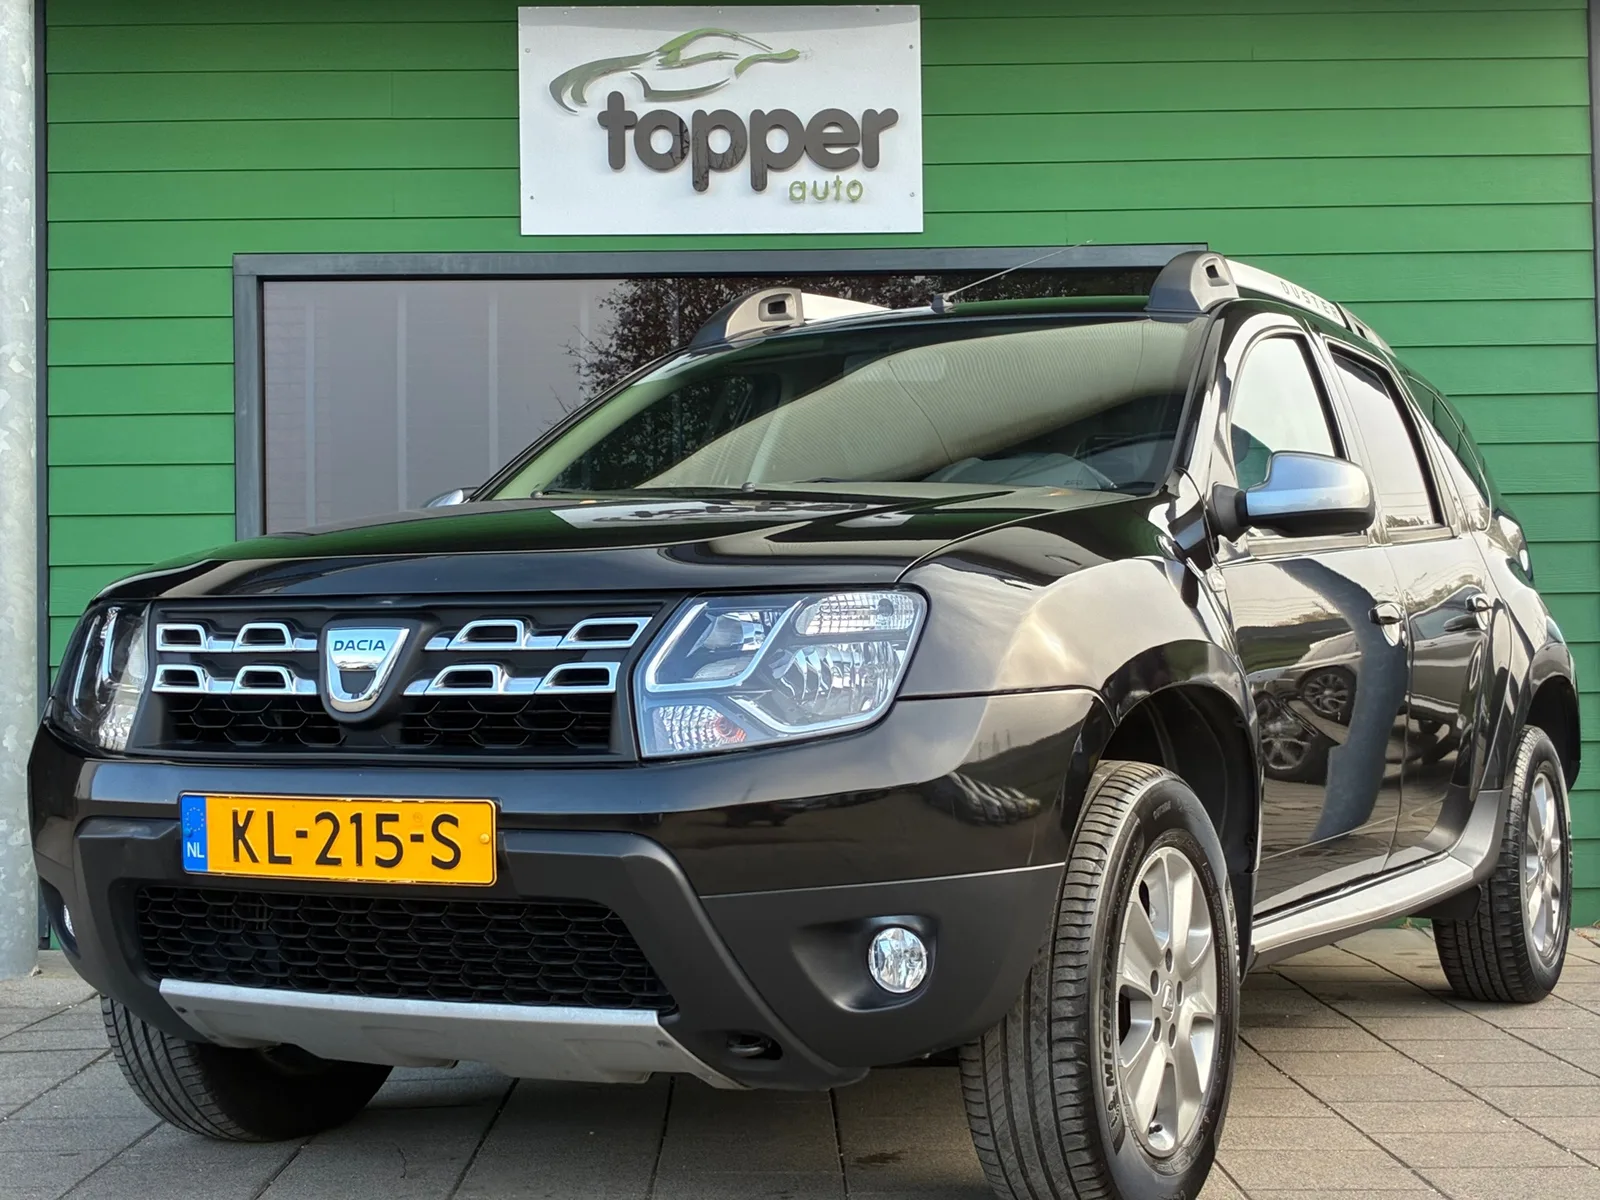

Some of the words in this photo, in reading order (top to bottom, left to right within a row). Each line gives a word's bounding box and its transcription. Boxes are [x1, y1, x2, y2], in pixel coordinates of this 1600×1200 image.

[598, 91, 899, 192] topper
[789, 175, 864, 201] auto
[333, 640, 386, 651] DACIA
[187, 842, 205, 858] NL
[232, 810, 462, 870] KL-215-S
